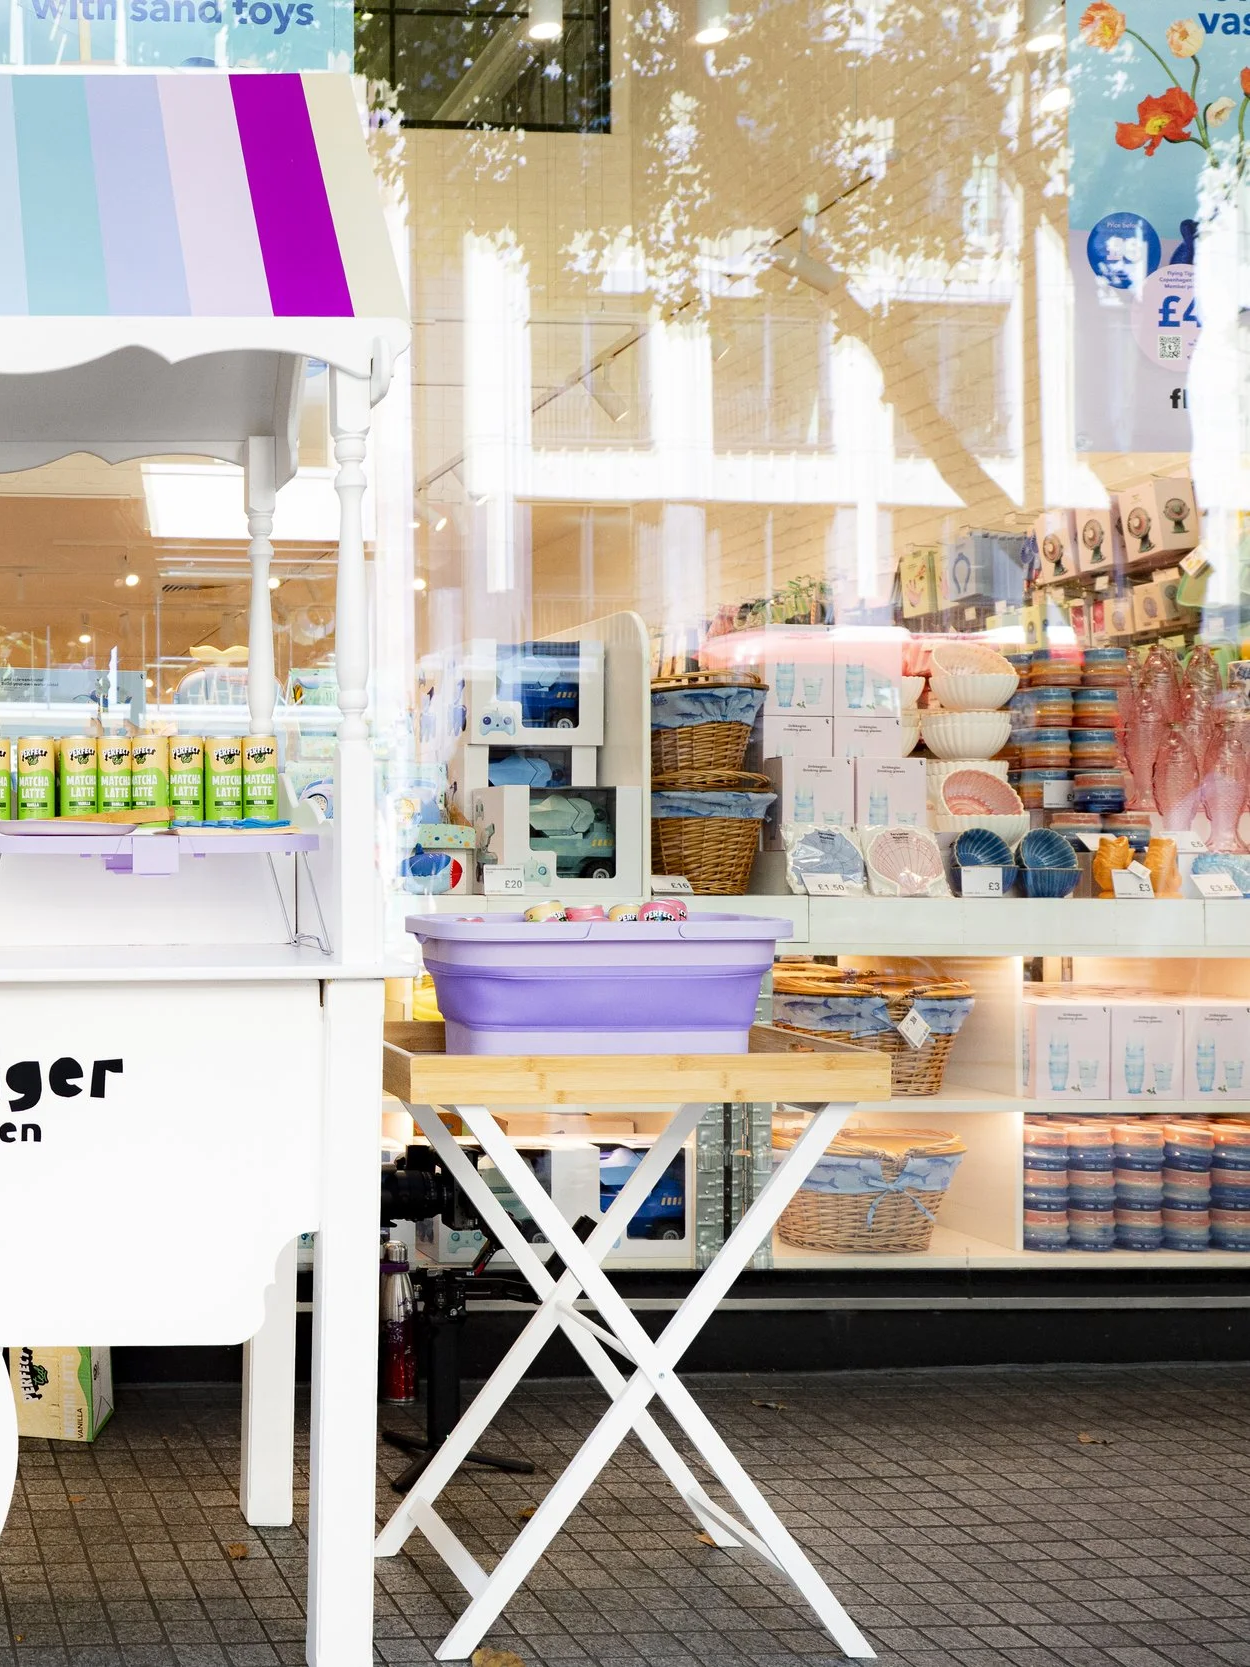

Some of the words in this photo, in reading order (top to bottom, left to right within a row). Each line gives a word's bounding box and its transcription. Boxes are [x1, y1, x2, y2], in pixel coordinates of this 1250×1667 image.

[35, 0, 116, 20] with
[130, 0, 222, 23] sand
[232, 0, 315, 35] toys
[19, 776, 49, 787] MATCHA
[170, 774, 201, 784] MATCHA
[244, 774, 275, 784] MATCHA
[22, 788, 45, 798] LATTE
[71, 788, 94, 797] LATTE
[105, 788, 128, 798] LATTE
[173, 786, 198, 796] LATTE
[216, 787, 239, 797] LATTE
[248, 786, 272, 796] LATTE
[504, 879, 523, 889] £20
[818, 883, 845, 891] £1.50
[988, 882, 1000, 891] £3
[1139, 883, 1150, 892] £3
[20, 1347, 40, 1404] PERFECT
